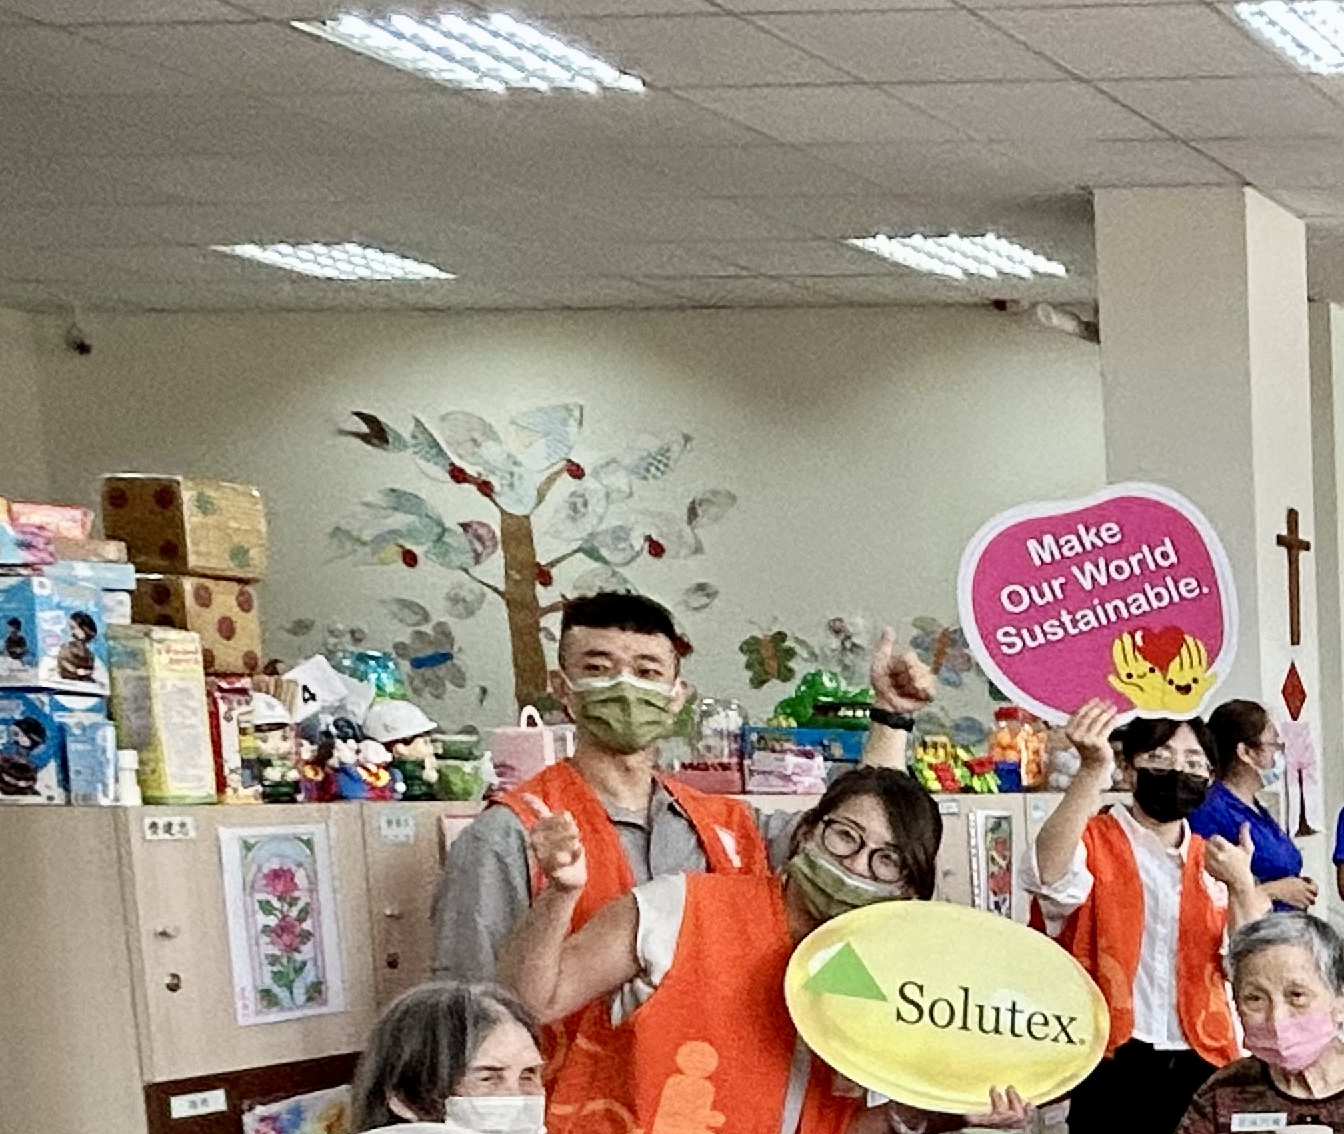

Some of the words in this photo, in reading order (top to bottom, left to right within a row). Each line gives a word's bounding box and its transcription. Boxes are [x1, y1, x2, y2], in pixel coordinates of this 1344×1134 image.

[999, 577, 1067, 616] Our
[1071, 537, 1180, 590] World
[1027, 521, 1122, 567] Make
[996, 576, 1210, 656] Sustainable.
